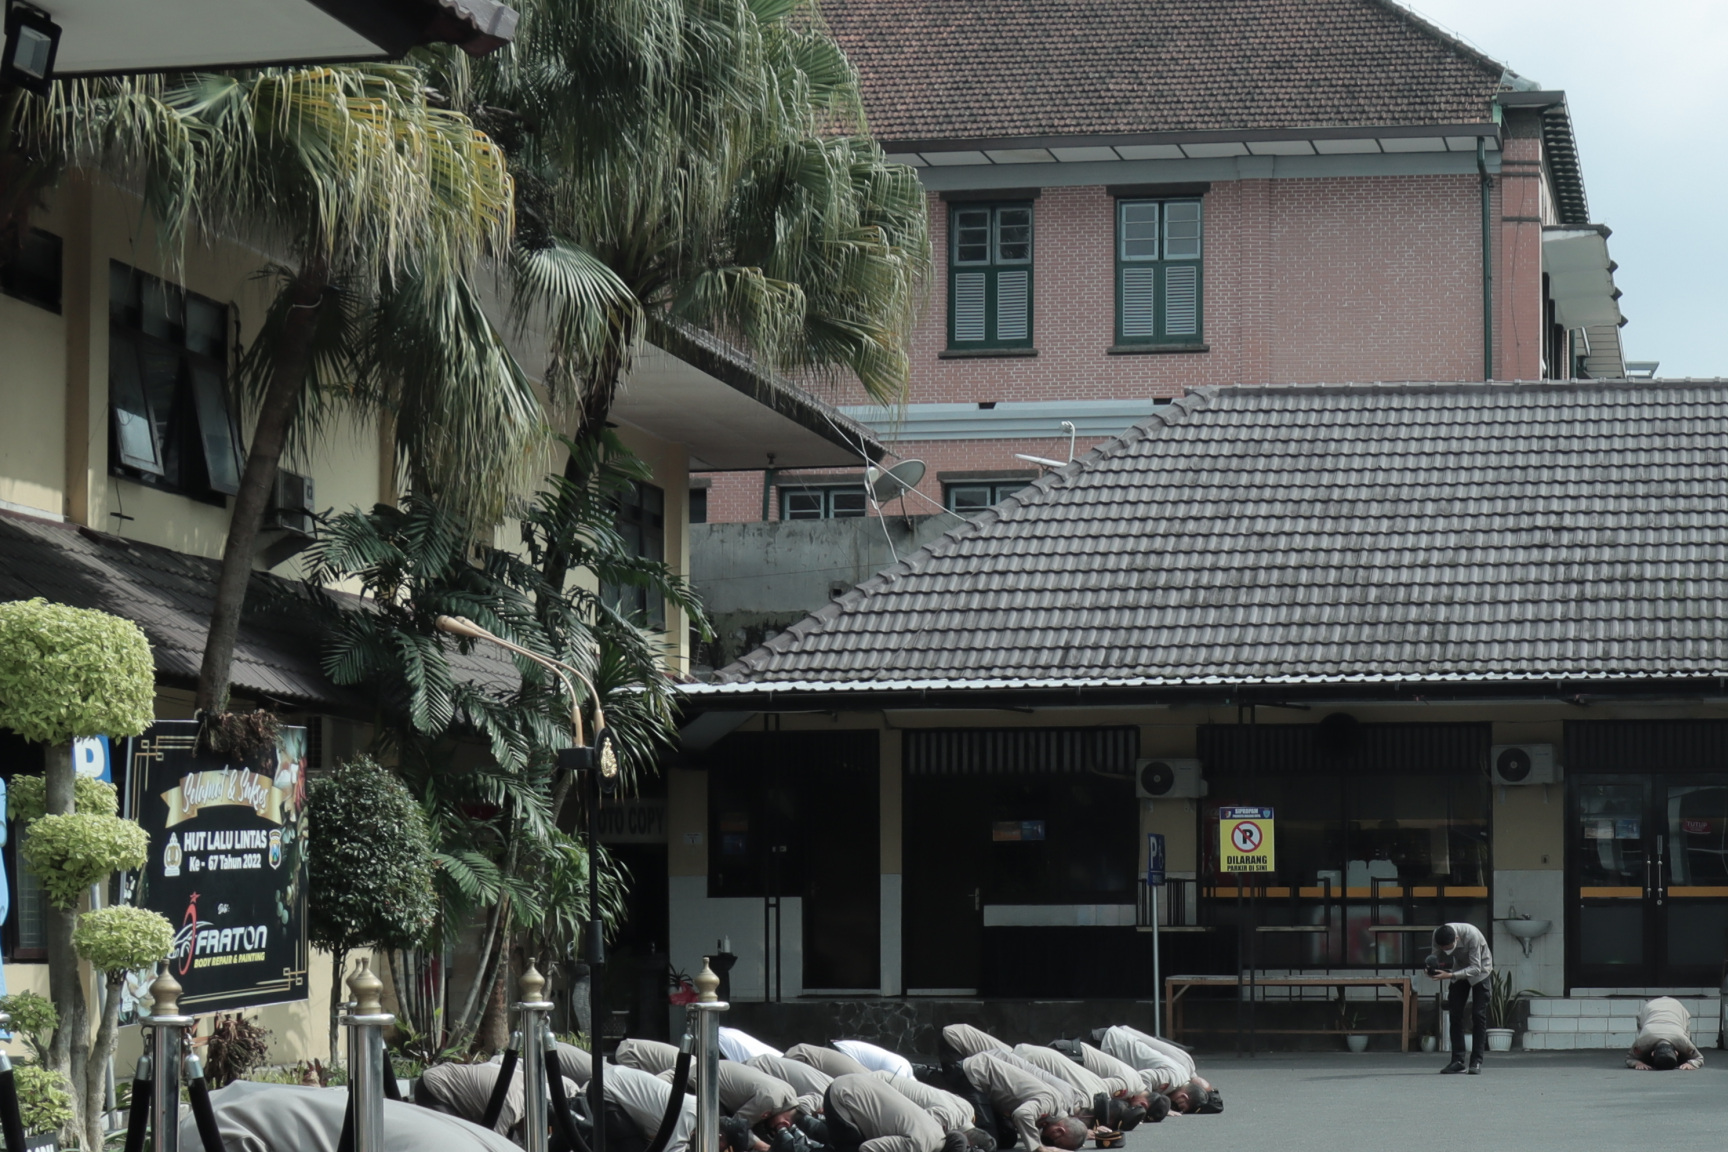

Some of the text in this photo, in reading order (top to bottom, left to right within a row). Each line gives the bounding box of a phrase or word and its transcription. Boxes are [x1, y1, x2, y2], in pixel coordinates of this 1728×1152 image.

[228, 769, 238, 803] &
[238, 767, 268, 811] Sukses
[597, 807, 665, 835] OTO COPY
[184, 829, 267, 851] HUT LALU LINTAS
[208, 855, 219, 871] 67
[220, 854, 242, 870] Tahun
[243, 853, 262, 869] 2022
[1150, 836, 1158, 869] P
[1227, 855, 1267, 864] DILARANG
[194, 952, 266, 968] BODY REPAIR & PAINTING
